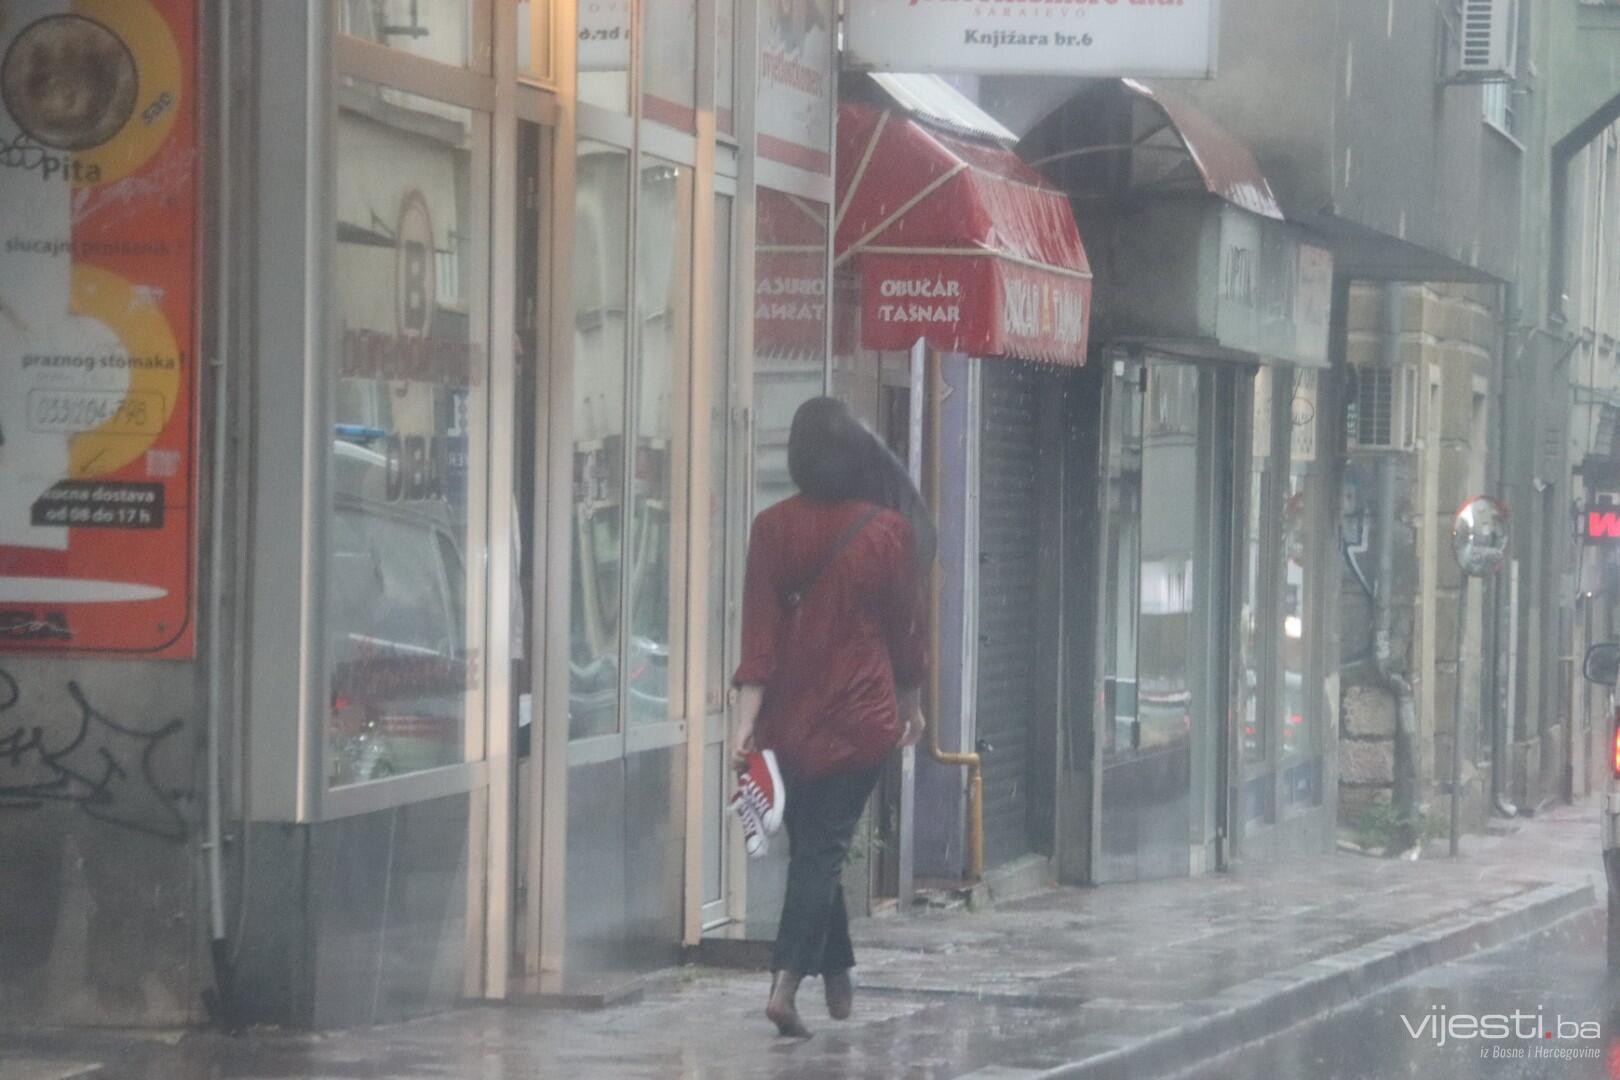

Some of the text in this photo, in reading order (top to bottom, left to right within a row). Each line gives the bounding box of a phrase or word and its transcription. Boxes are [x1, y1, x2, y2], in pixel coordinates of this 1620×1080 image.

[1055, 31, 1094, 46] br.6
[42, 156, 102, 181] Pita
[21, 355, 95, 371] praznog
[91, 486, 155, 503] dostava
[46, 505, 68, 521] od
[91, 506, 115, 522] do
